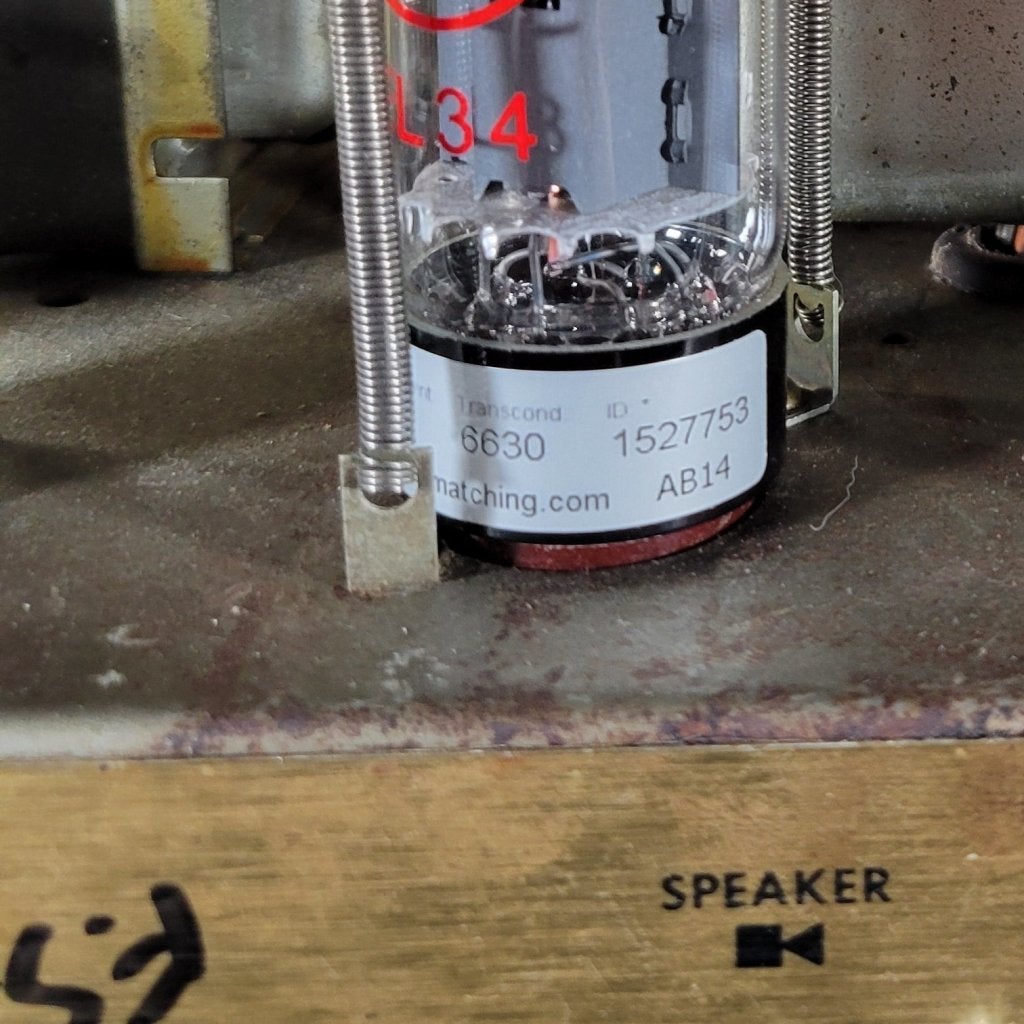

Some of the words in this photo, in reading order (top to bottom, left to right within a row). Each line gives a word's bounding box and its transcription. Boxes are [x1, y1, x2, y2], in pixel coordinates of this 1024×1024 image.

[386, 67, 538, 163] L34
[457, 394, 563, 423] Transcond
[460, 424, 546, 462] 6630
[613, 395, 750, 458] 1527753
[656, 453, 732, 502] AB14
[660, 867, 893, 911] SPEAKER
